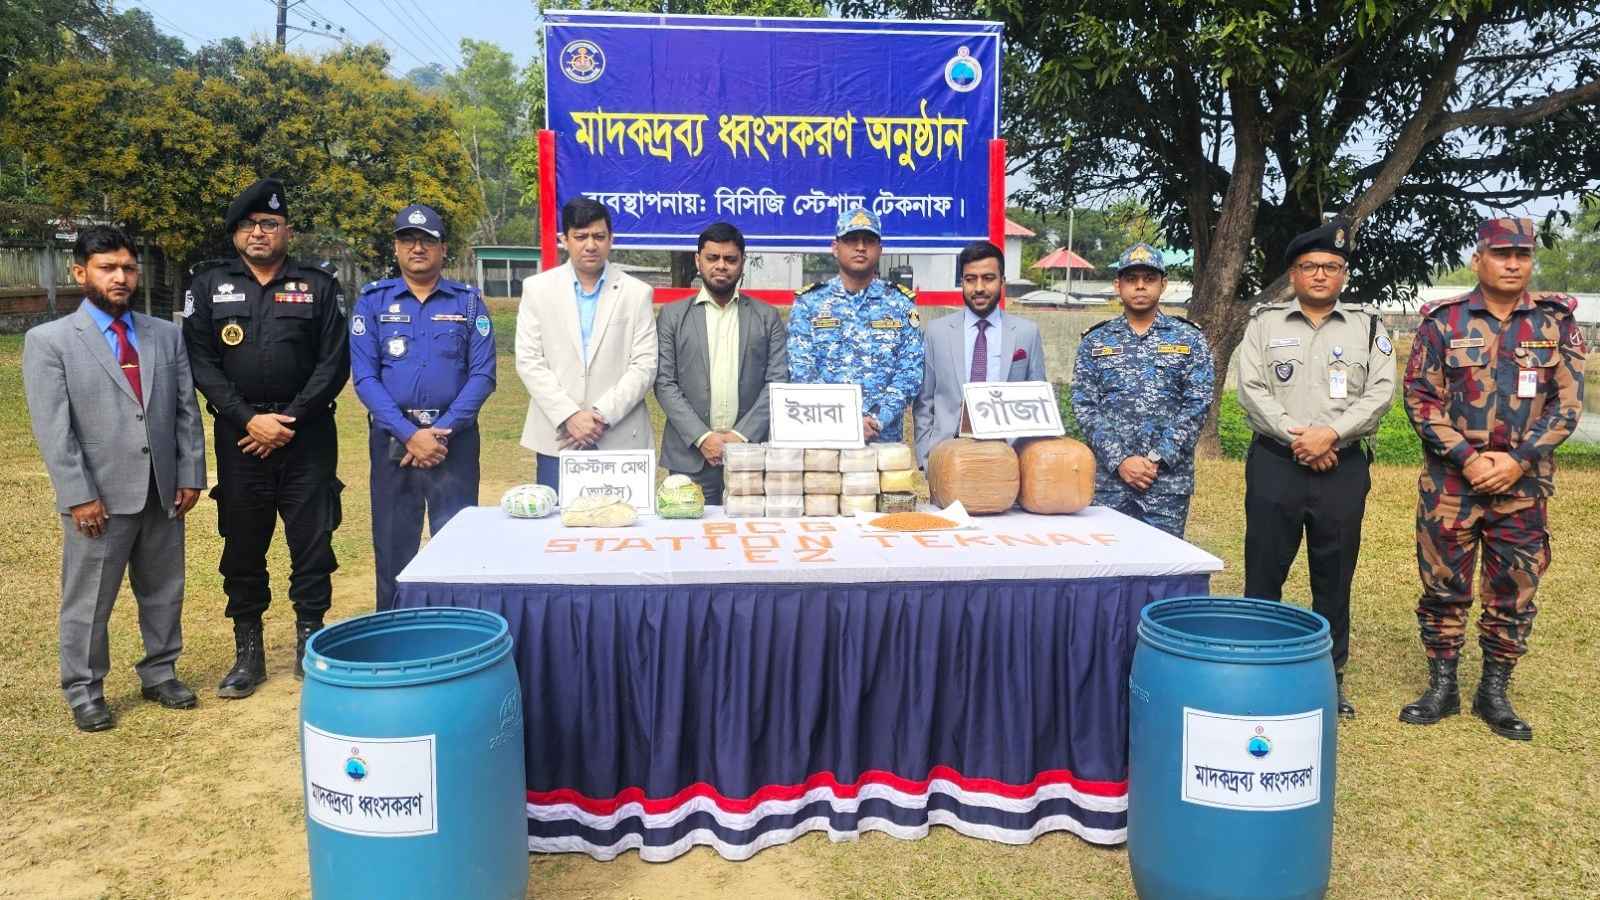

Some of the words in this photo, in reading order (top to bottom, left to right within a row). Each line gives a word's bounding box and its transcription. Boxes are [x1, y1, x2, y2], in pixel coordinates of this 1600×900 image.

[570, 107, 708, 162] মাদকদ্রব্য
[719, 111, 857, 161] ধ্বংসকরণ
[865, 99, 968, 171] অনুষ্ঠান
[714, 186, 786, 215] বিসিজি
[784, 398, 845, 425] ইয়াবা
[975, 391, 1052, 427] গাঁজা
[564, 458, 617, 475] ক্রিস্টাল
[621, 458, 648, 474] মেথ
[545, 535, 833, 553] STATION
[859, 532, 1121, 550] TEKNAF
[1194, 764, 1256, 794] মাদকদ্রব্য
[1259, 764, 1315, 794] ধ্বংসকরণ
[311, 782, 354, 816] মাদকদ্রব্য
[357, 791, 424, 820] ধ্বংসকরণ
